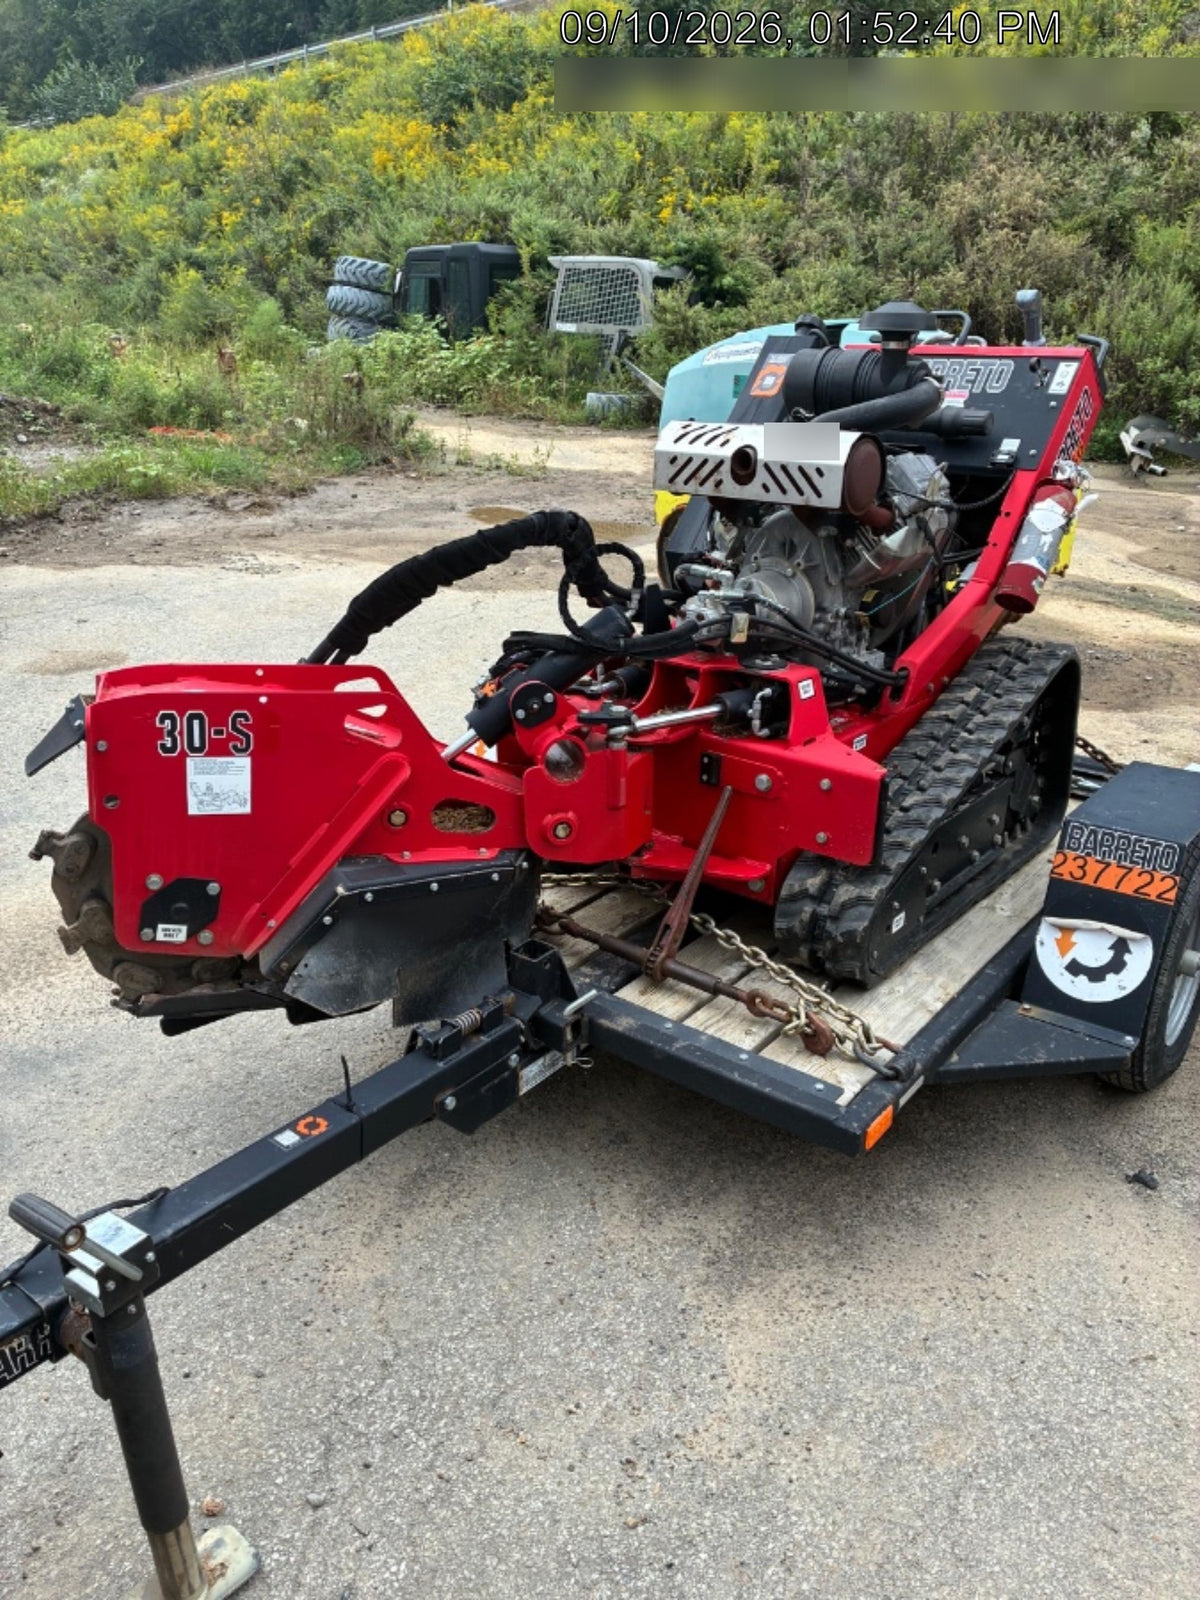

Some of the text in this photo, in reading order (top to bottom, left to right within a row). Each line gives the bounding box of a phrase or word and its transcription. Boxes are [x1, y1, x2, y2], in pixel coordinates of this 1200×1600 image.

[156, 710, 253, 756] 30-S
[1066, 822, 1179, 874] BARRETO
[1051, 851, 1177, 902] 237722
